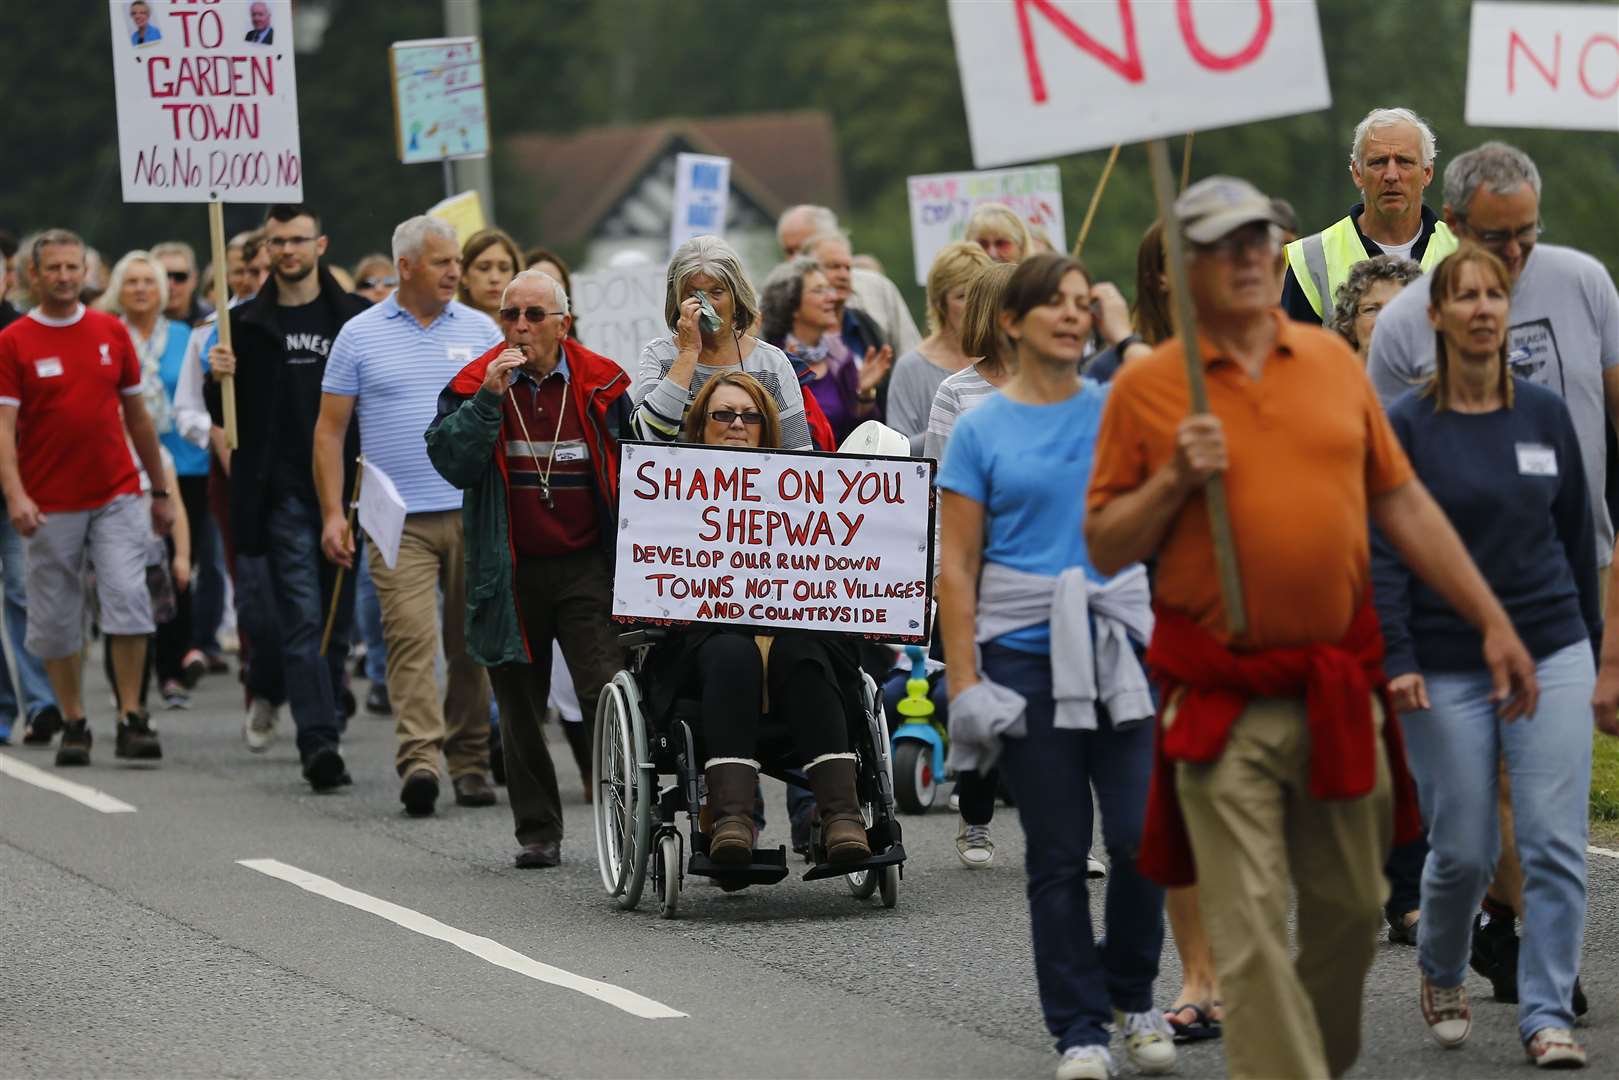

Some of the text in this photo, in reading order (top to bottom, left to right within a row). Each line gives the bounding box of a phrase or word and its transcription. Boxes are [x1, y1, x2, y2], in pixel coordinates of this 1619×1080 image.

[168, 9, 223, 49] TO
[1014, 0, 1275, 104] NO
[1505, 27, 1619, 103] NO
[161, 102, 260, 142] TOWN
[632, 460, 906, 505] SHAME ON YOU
[698, 505, 866, 547] SHEPWAY
[632, 543, 881, 572] DEVELOP OUR RUN DOWN
[645, 572, 926, 602] TOWNS NOT OUR VILLAGES
[696, 600, 888, 623] AND COUNTRYSIDE
